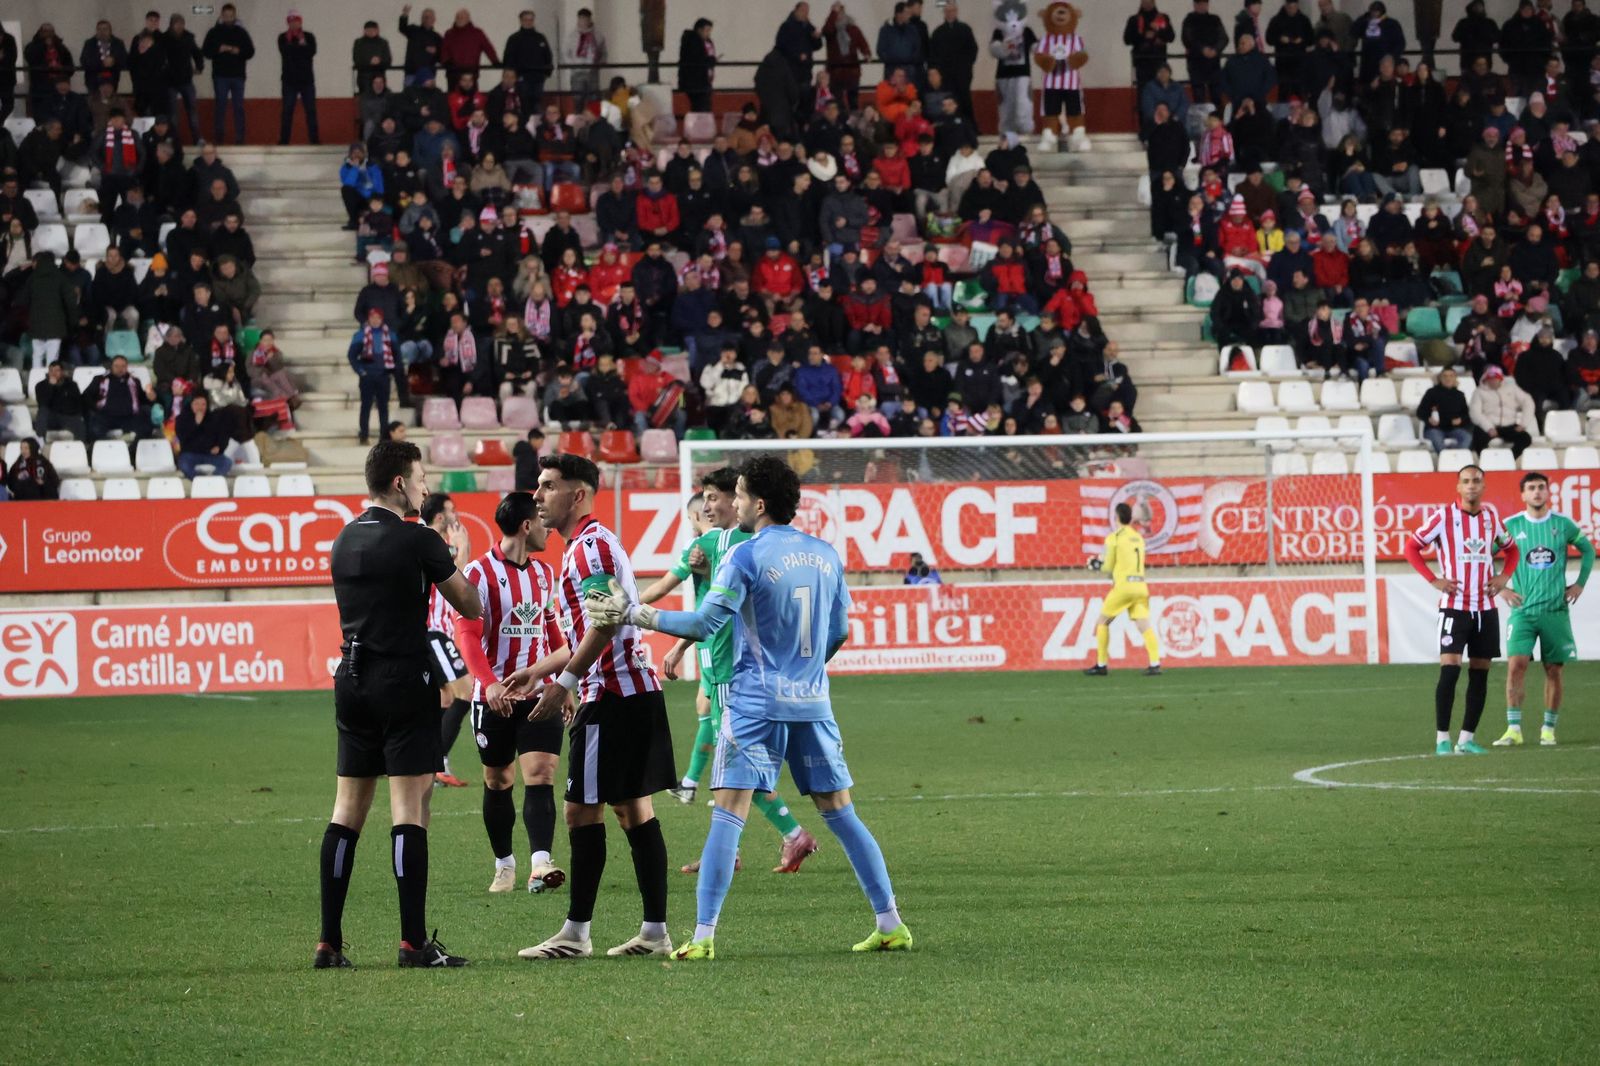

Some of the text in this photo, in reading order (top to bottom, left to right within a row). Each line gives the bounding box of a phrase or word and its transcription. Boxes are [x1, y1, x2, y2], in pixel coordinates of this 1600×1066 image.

[629, 485, 1047, 571] ZRA CF
[1215, 505, 1360, 534] CENTRO
[42, 528, 91, 548] Grupo
[1280, 530, 1436, 558] ROBERT
[44, 545, 144, 564] Leomotor
[196, 556, 330, 574] EMBUTIDOS
[767, 552, 832, 584] M. PARERA
[1134, 547, 1141, 573] 1
[91, 615, 254, 649] Carné Joven
[501, 627, 522, 635] CAJA
[791, 586, 813, 658] 1
[848, 602, 995, 646] iller
[1290, 591, 1369, 656] CF
[446, 641, 459, 658] 2
[93, 650, 284, 692] Castilla y León
